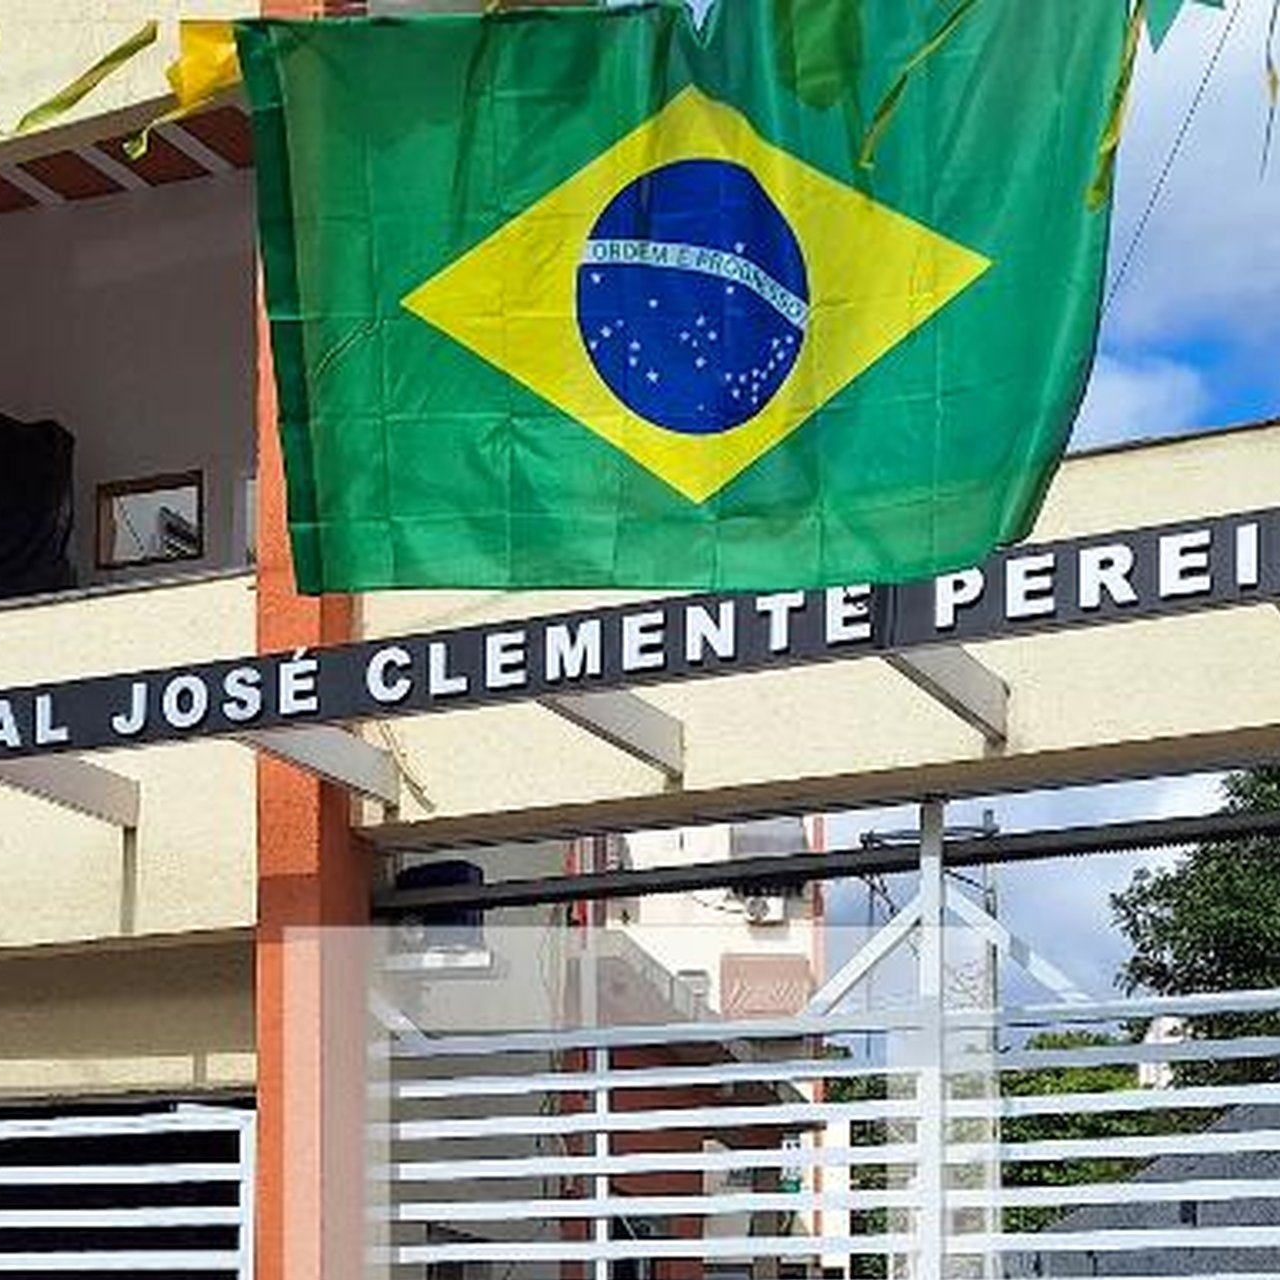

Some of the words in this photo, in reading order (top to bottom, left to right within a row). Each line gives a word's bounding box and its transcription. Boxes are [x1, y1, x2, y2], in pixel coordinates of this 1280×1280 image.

[592, 242, 669, 263] ORDEM
[677, 249, 692, 268] E
[111, 646, 320, 736] JOSÉ
[364, 582, 872, 703] CLEMENTE
